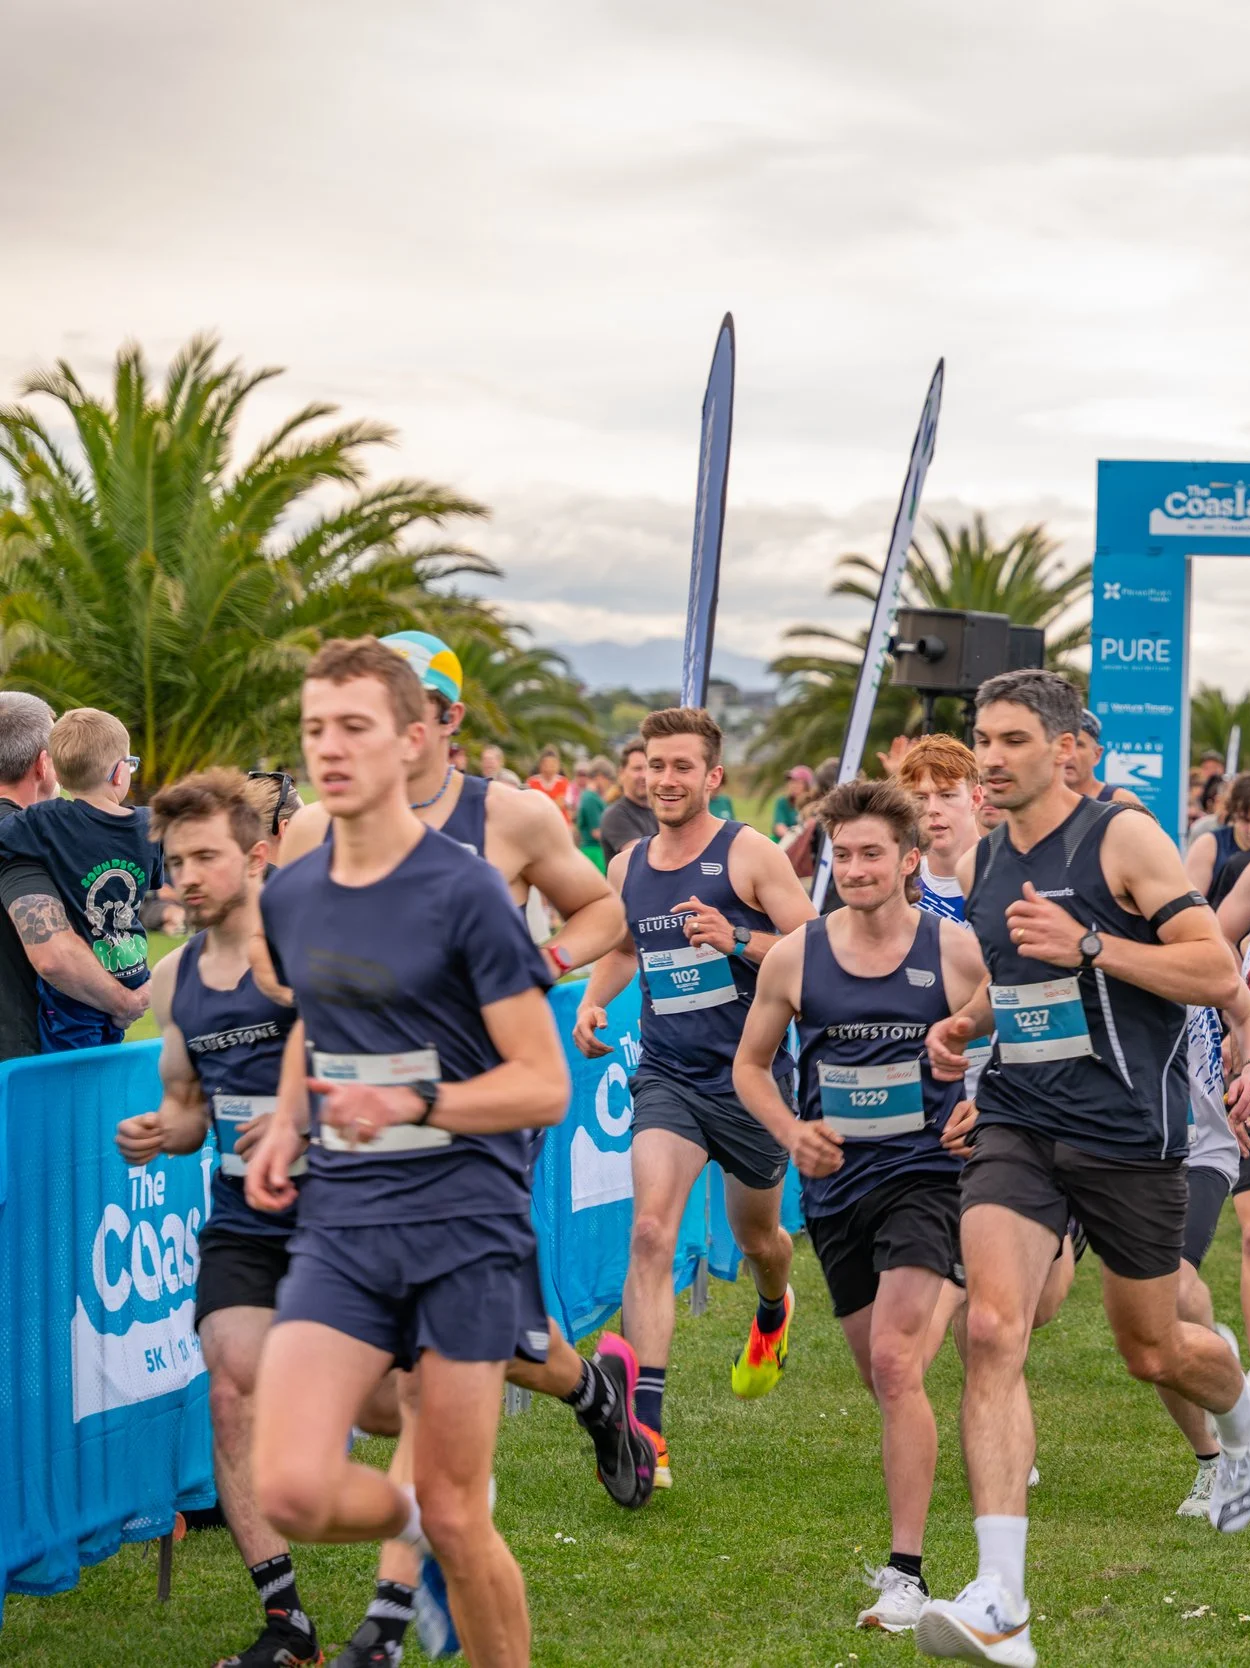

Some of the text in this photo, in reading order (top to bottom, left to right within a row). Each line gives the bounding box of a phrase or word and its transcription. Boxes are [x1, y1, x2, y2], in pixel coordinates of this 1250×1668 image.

[1186, 485, 1211, 497] The
[1101, 637, 1172, 663] PURE
[1106, 741, 1164, 752] TIMARU
[670, 968, 701, 984] 1102
[1014, 1010, 1050, 1027] 1237
[849, 1089, 889, 1107] 1329
[128, 1165, 166, 1211] The
[144, 1346, 167, 1373] 5K
